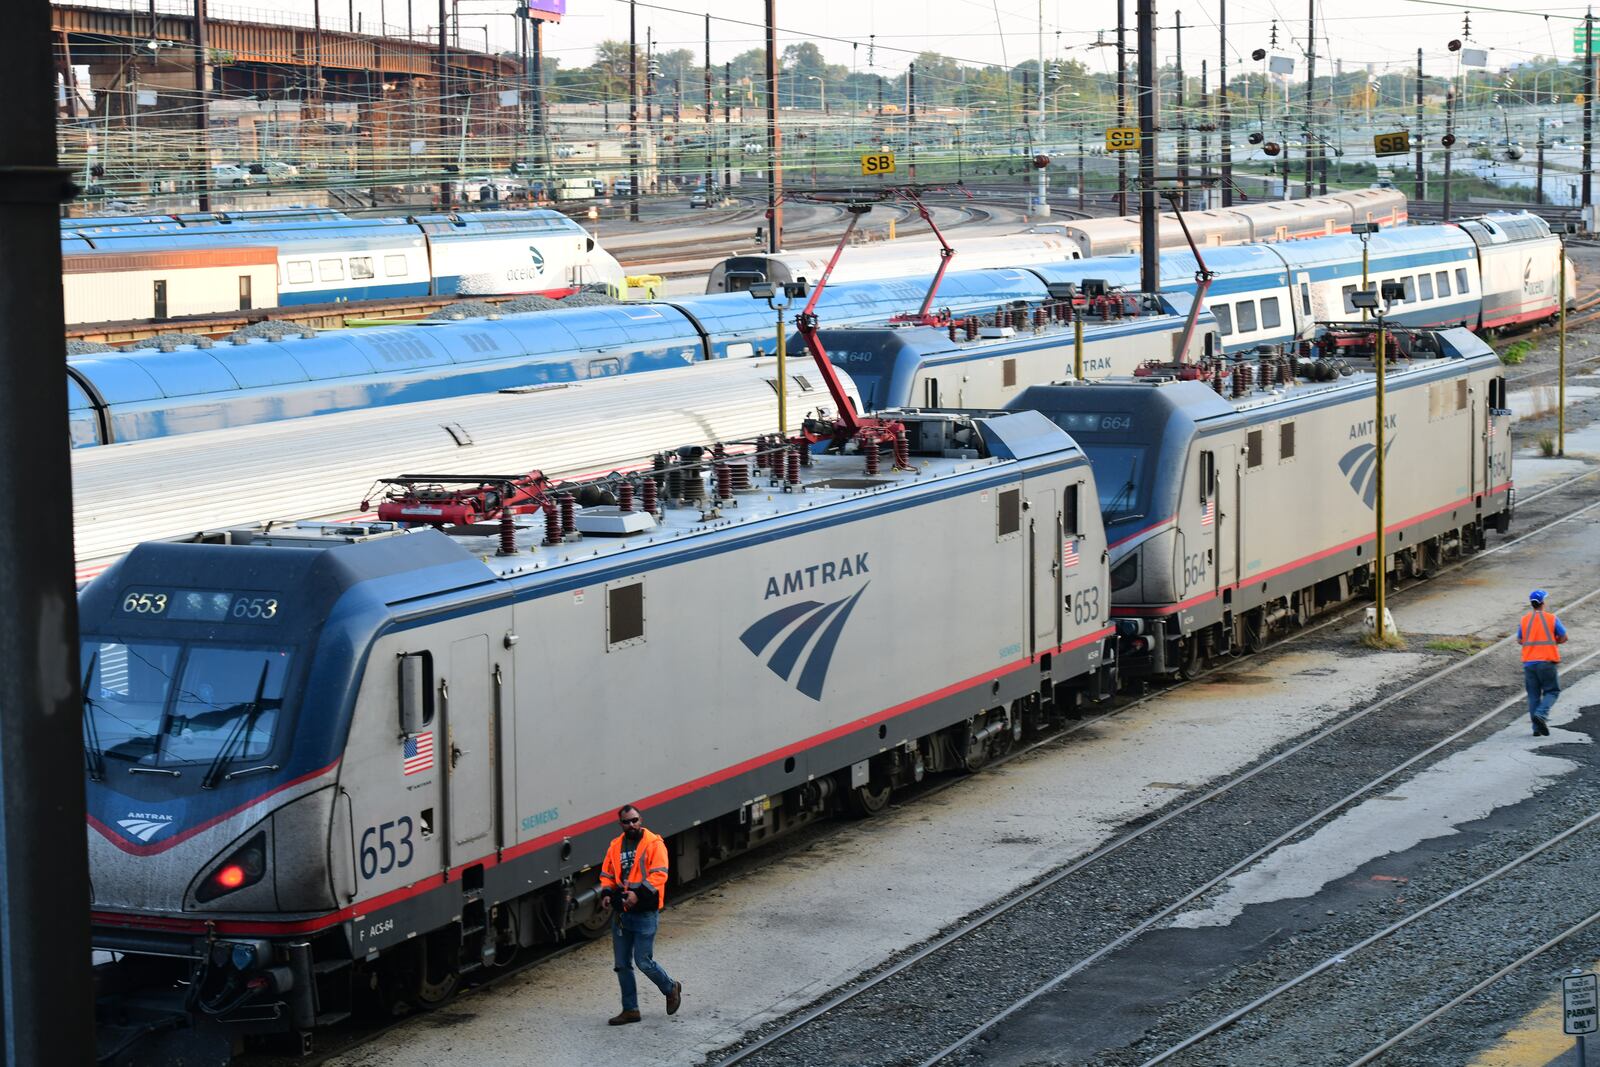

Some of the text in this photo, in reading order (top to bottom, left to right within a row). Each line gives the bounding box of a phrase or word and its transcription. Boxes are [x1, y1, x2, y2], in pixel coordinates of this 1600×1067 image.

[1111, 132, 1134, 147] SB
[1380, 136, 1404, 152] SB
[867, 156, 890, 171] SB
[849, 351, 873, 362] 640
[1065, 356, 1112, 375] ATRAK
[1101, 416, 1131, 430] 664
[1349, 413, 1397, 440] AMTAK
[764, 551, 870, 601] AMTRAK
[1184, 550, 1206, 588] 664
[122, 592, 167, 614] 653
[233, 597, 278, 620] 653
[1074, 585, 1099, 626] 653
[127, 811, 174, 821] AMTRAK
[521, 807, 559, 831] SIEMENS
[359, 815, 414, 880] 653
[360, 918, 394, 942] F ACS-64
[1567, 1006, 1597, 1019] PARKING
[1573, 1020, 1592, 1030] ONLY
